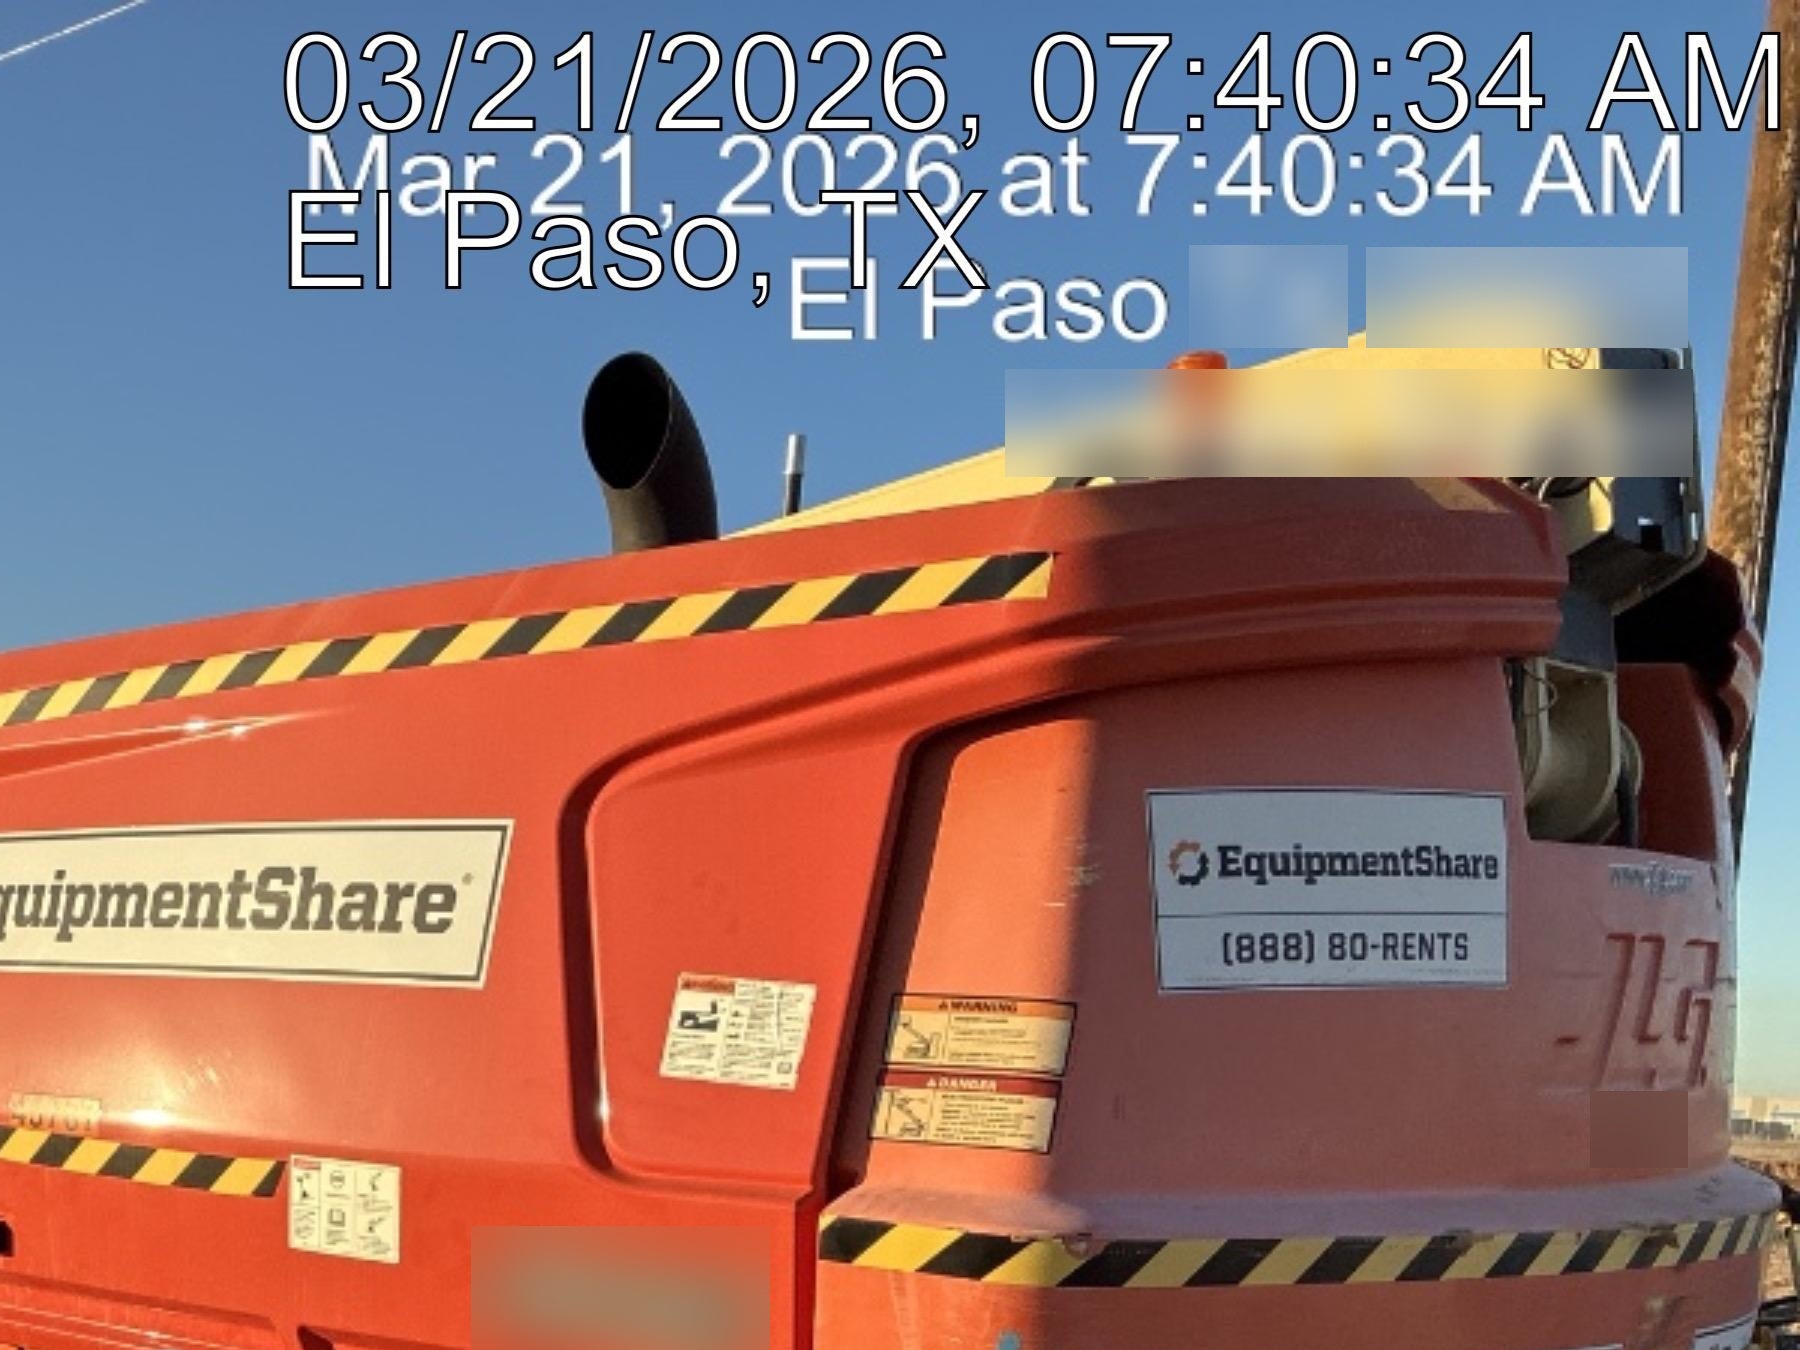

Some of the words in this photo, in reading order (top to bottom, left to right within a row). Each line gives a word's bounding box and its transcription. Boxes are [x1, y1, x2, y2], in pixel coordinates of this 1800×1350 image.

[1217, 843, 1498, 885] EquipmentShare
[1222, 930, 1315, 965] (888)
[1328, 932, 1469, 961] 80-RENTS
[951, 1000, 1018, 1013] WARNING
[938, 1077, 997, 1091] DANGER
